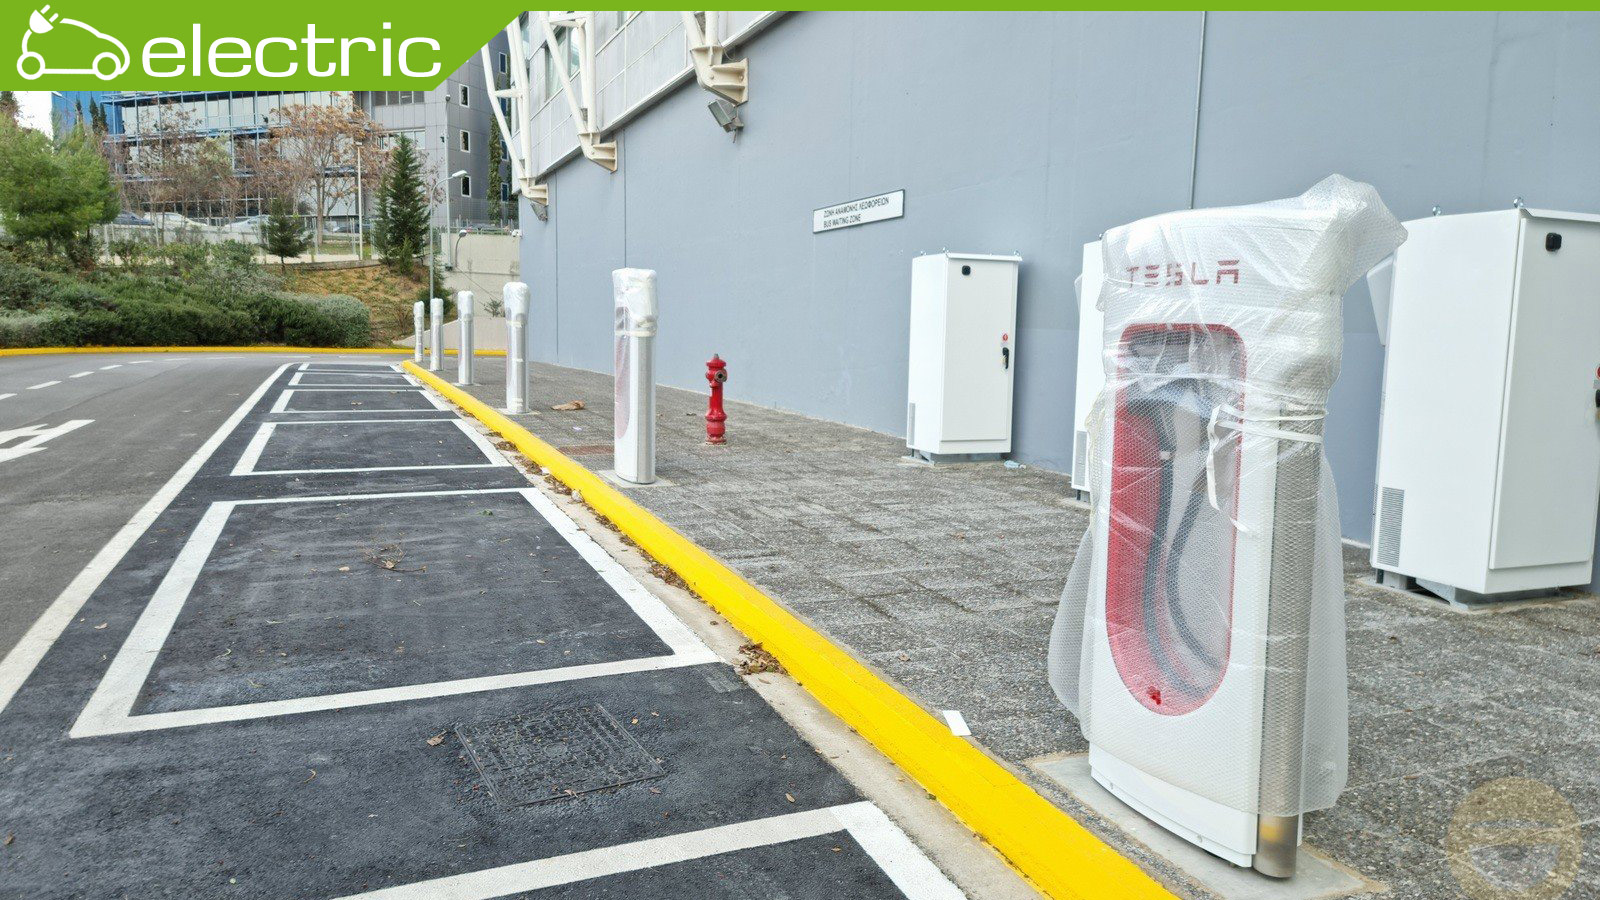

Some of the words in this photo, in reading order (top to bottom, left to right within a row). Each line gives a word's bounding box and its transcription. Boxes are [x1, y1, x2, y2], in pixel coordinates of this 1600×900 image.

[823, 219, 832, 228] BUS
[832, 216, 849, 226] WAITING
[849, 213, 861, 223] ZONE
[1126, 259, 1240, 289] TESLA
